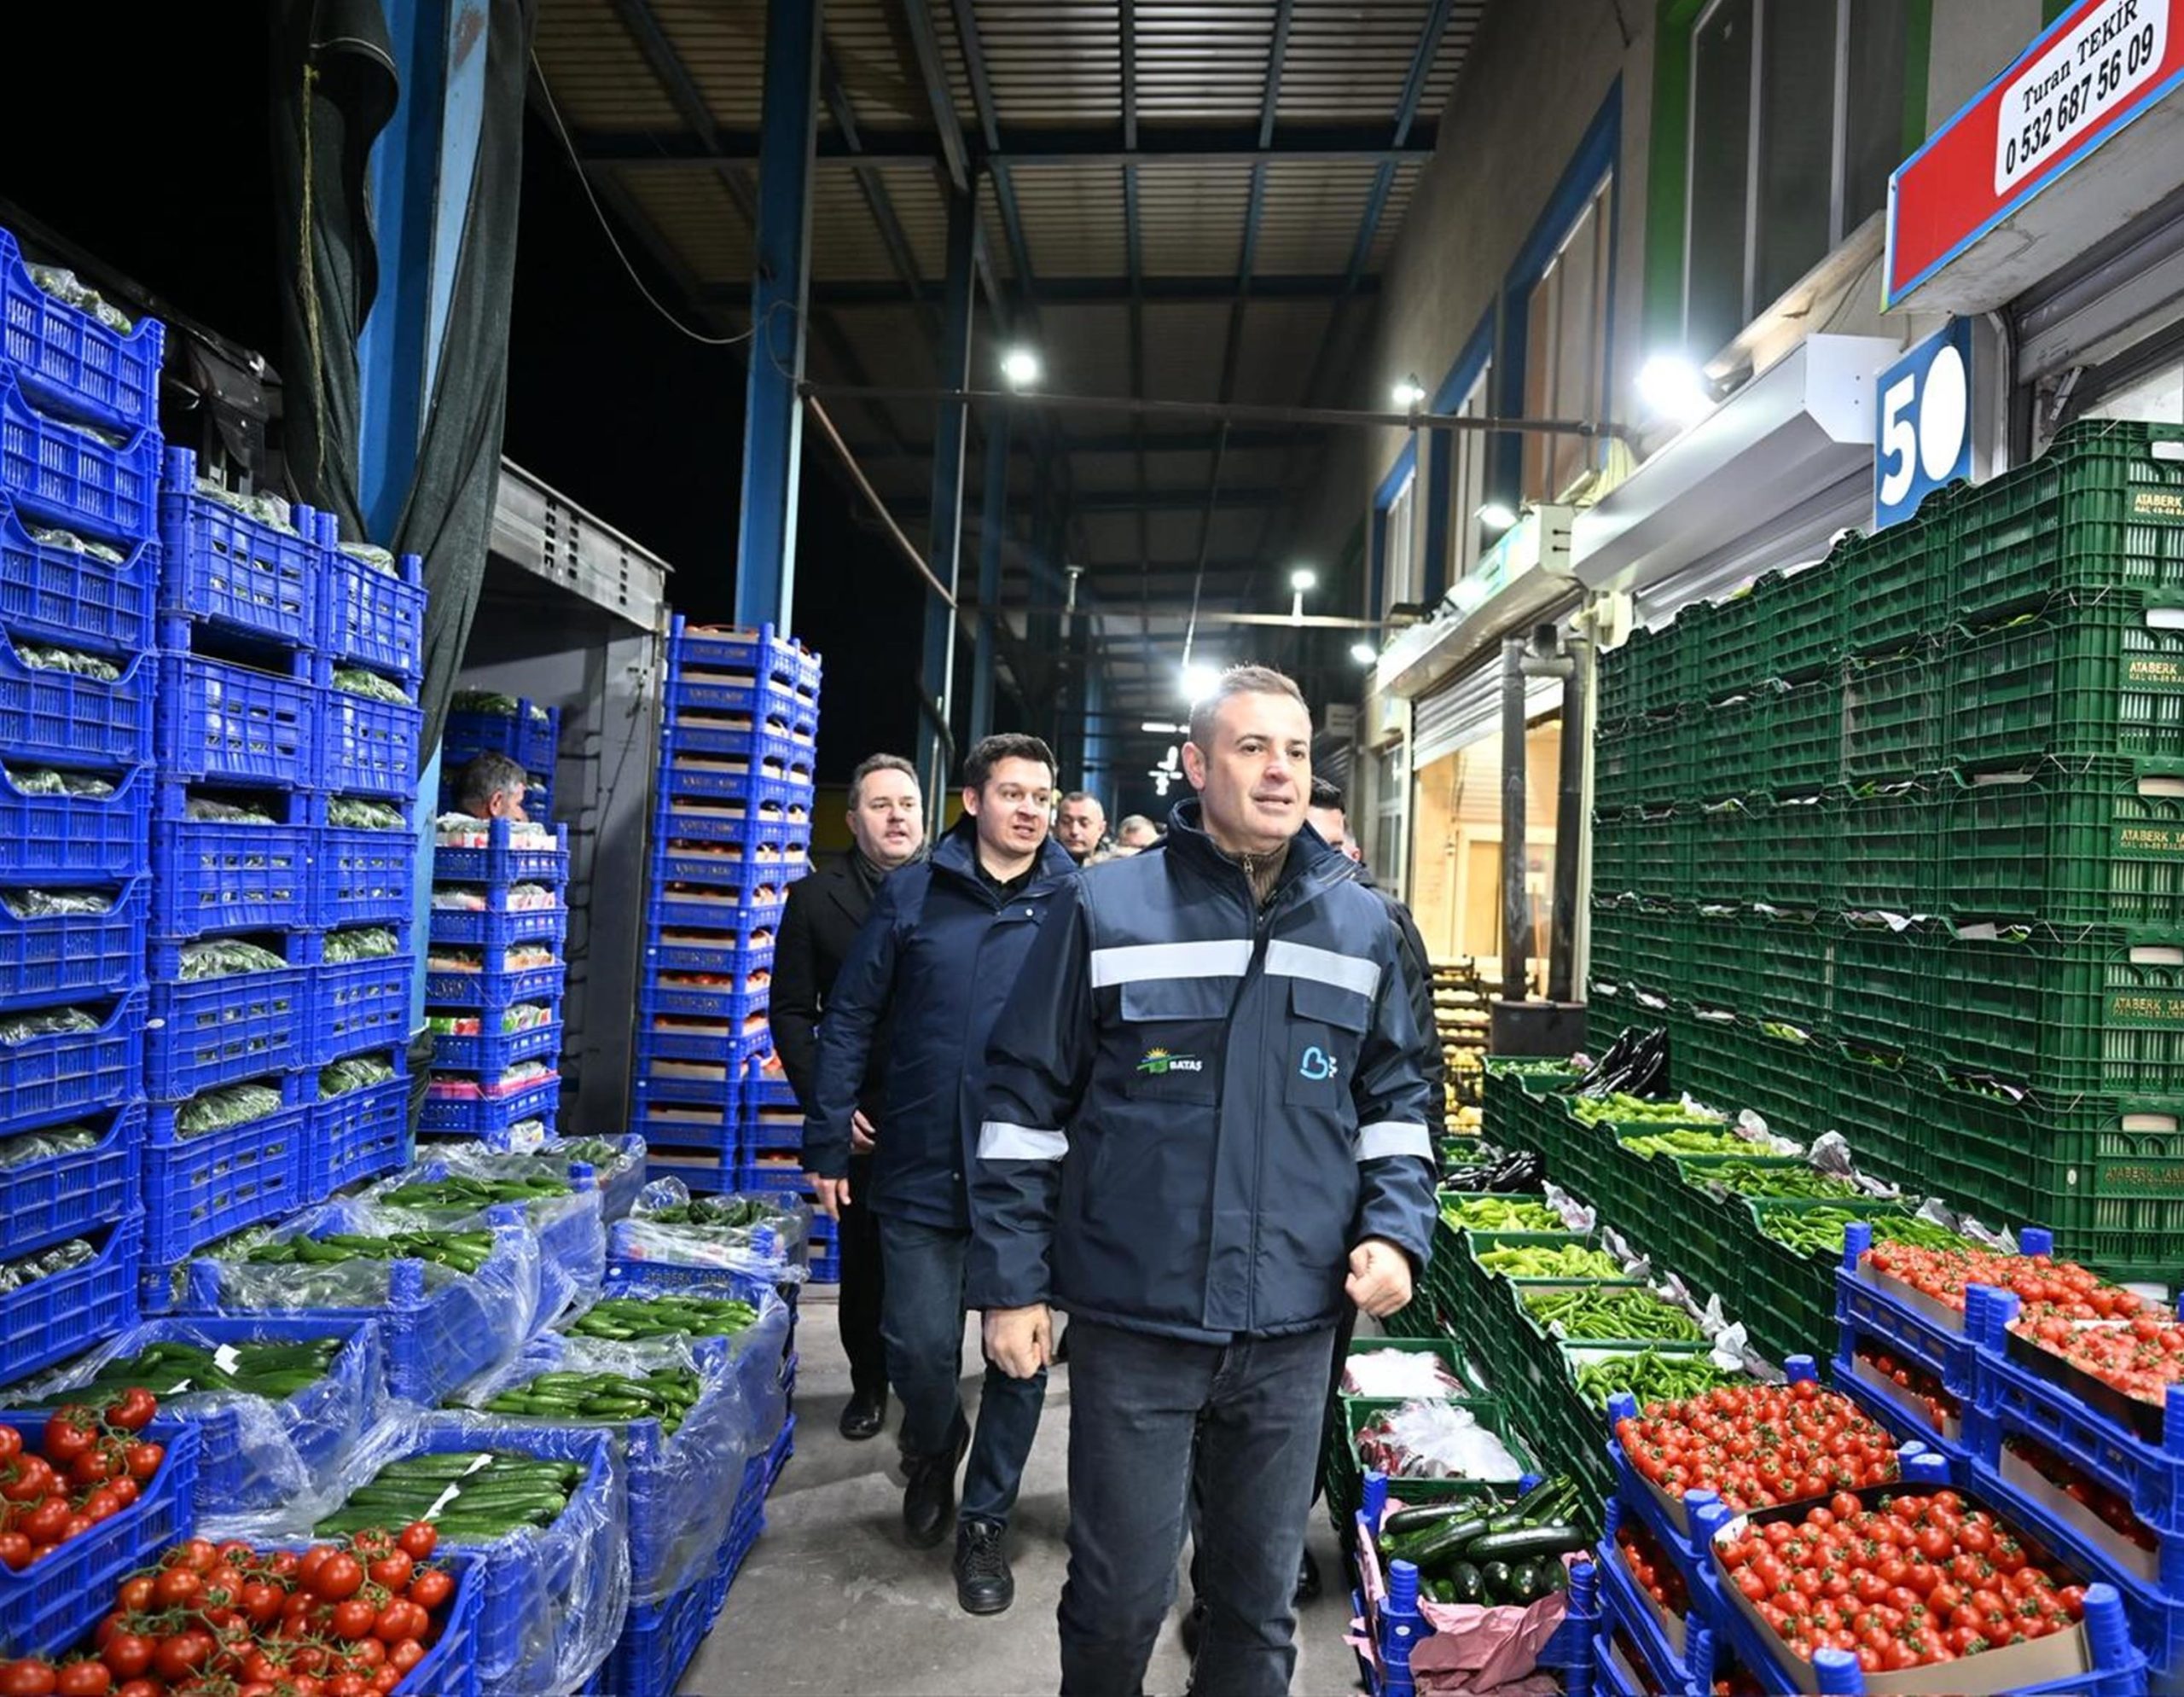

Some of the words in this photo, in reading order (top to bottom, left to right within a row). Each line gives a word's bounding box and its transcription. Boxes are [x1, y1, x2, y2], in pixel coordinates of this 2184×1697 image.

[2023, 60, 2071, 113] Turan
[2077, 0, 2138, 66] TEKİR
[2006, 137, 2016, 175] 0
[2020, 108, 2053, 163] 532
[2057, 73, 2092, 132] 687
[2097, 49, 2122, 102] 56
[2128, 23, 2154, 76] 09
[2135, 494, 2183, 509] ATABERK
[2129, 661, 2177, 675] ATABERK
[2120, 828, 2169, 843] ATABERK
[2114, 997, 2162, 1012] ATABERK
